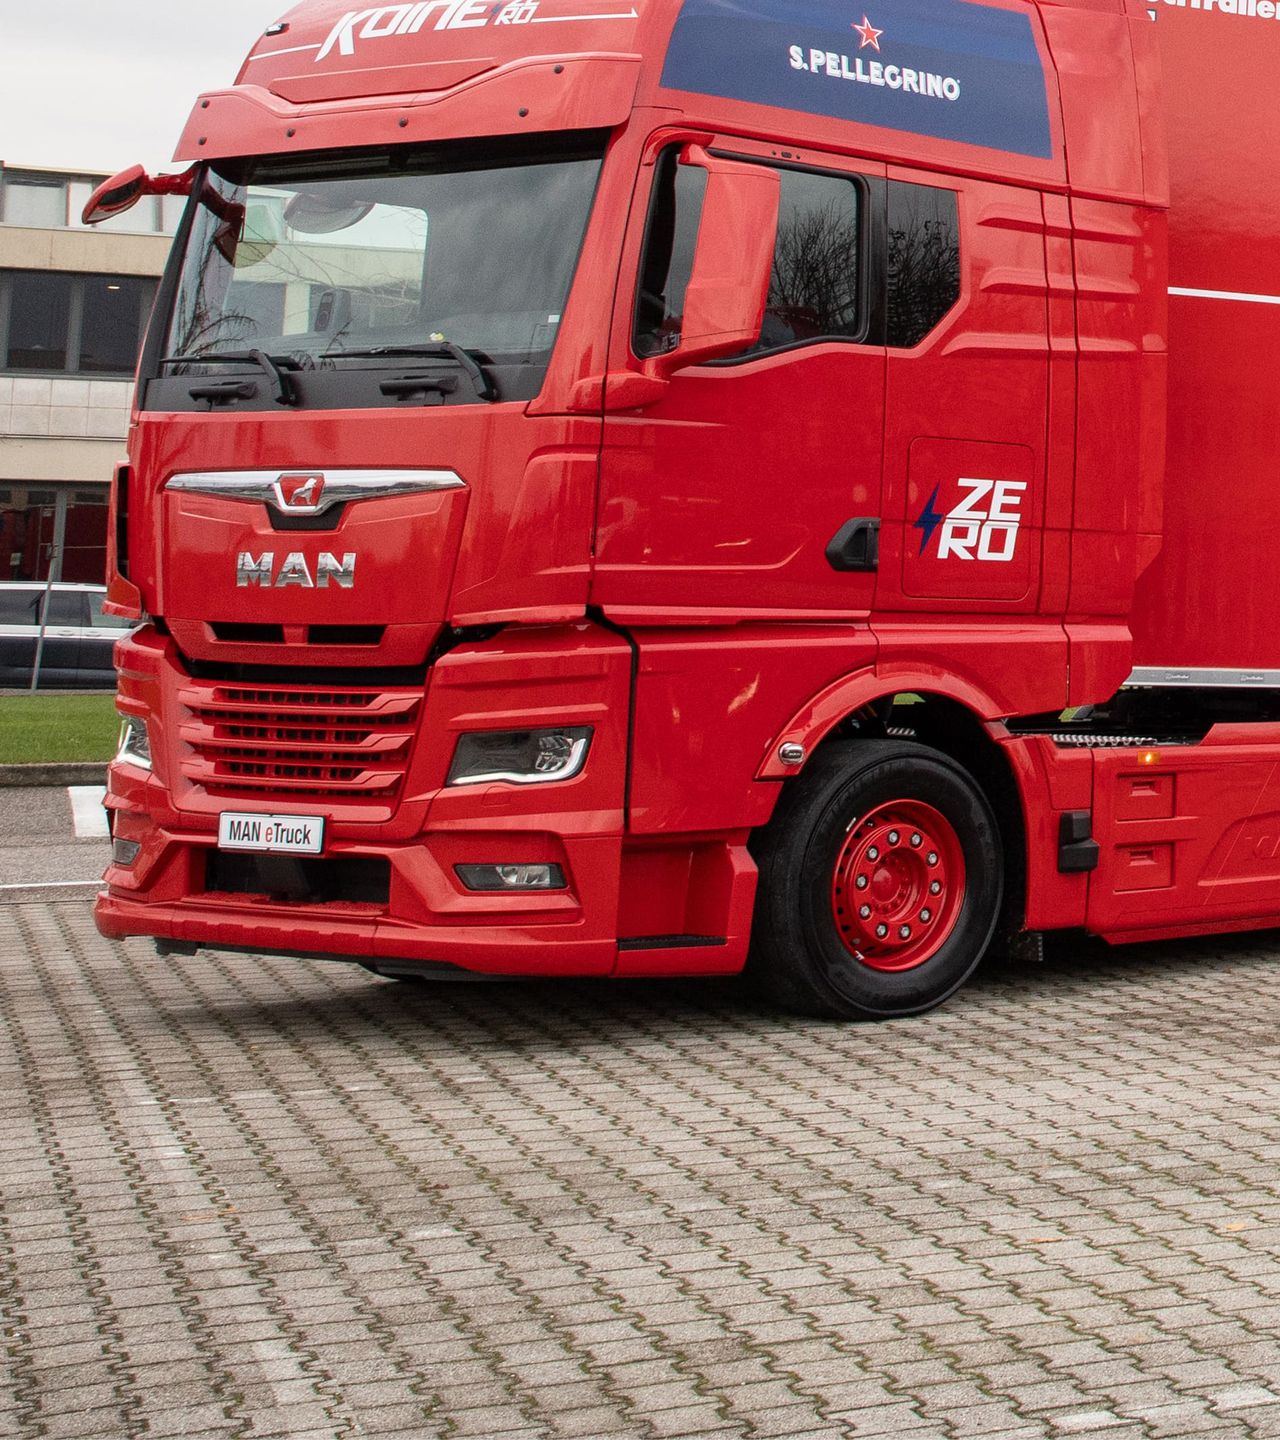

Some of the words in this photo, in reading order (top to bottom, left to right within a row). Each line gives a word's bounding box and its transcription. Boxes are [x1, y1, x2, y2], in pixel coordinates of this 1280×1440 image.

[235, 551, 357, 589] MAN
[229, 820, 262, 844] MAN
[265, 823, 312, 846] eTruck
